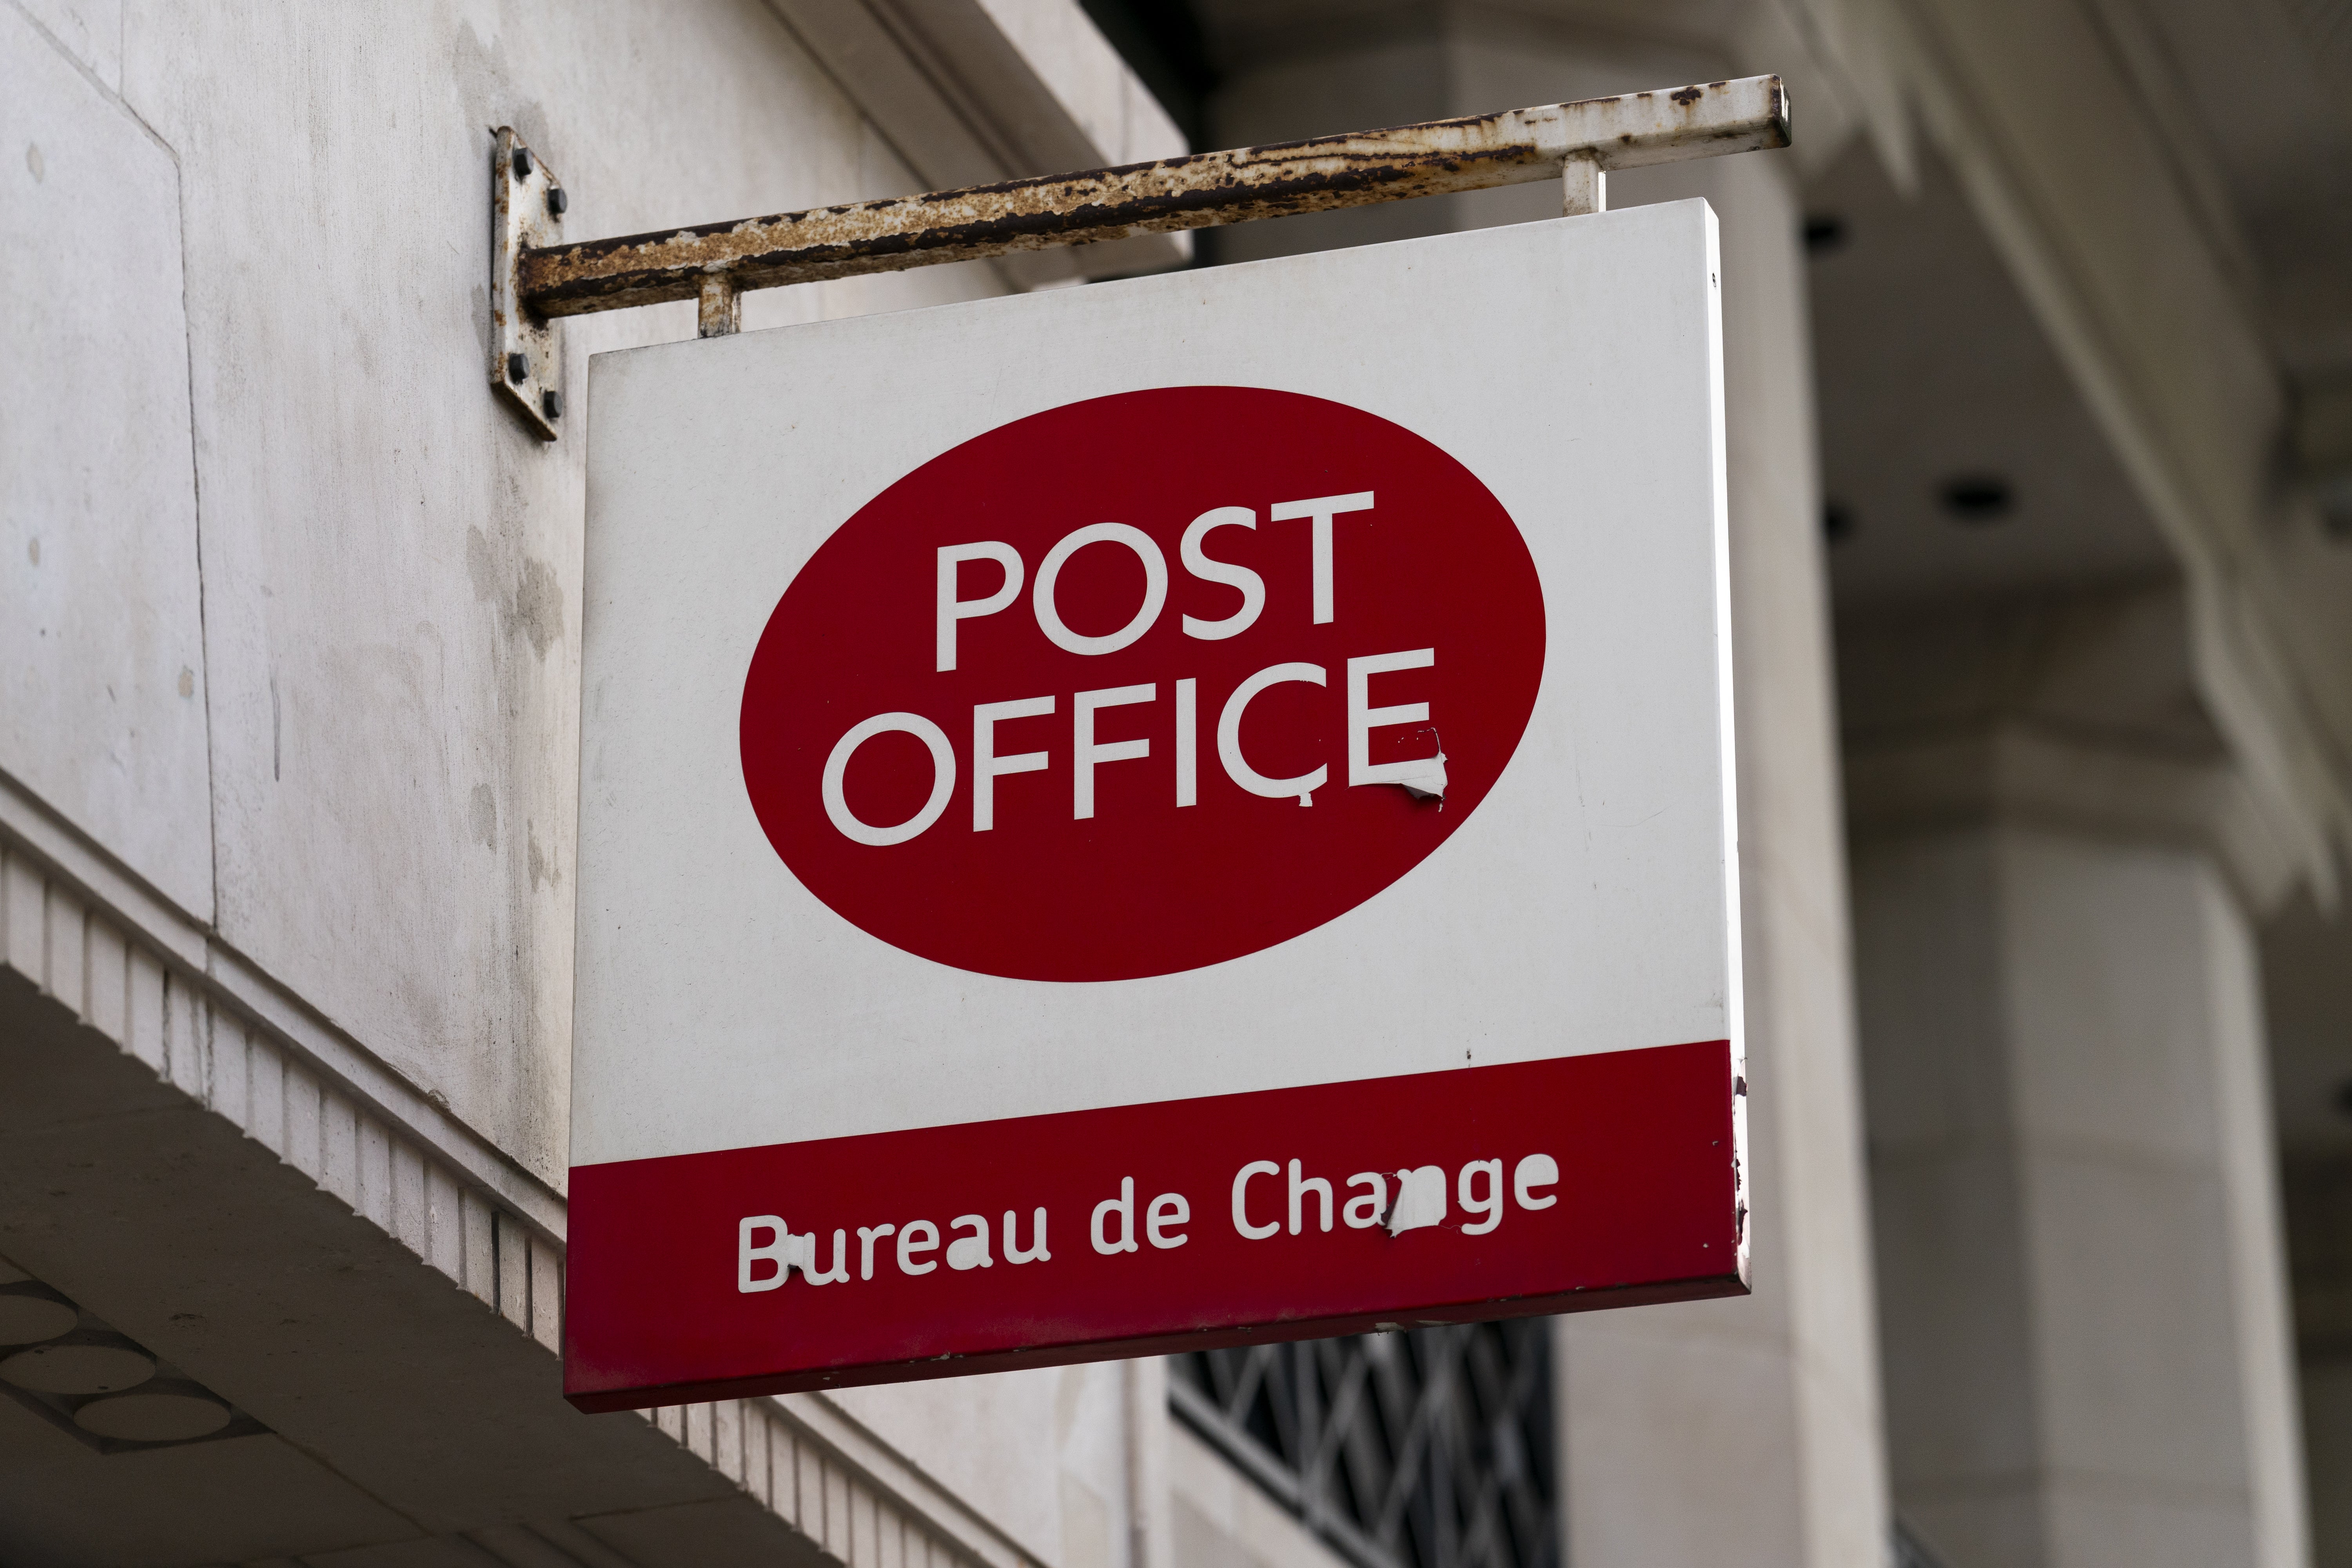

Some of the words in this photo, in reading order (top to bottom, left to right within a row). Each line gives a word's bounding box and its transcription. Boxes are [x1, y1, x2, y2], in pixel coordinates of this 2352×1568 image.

[936, 491, 1374, 672] POST
[822, 648, 1446, 846] OFFICE
[738, 1207, 1051, 1293] Bureau
[1091, 1176, 1190, 1255] de
